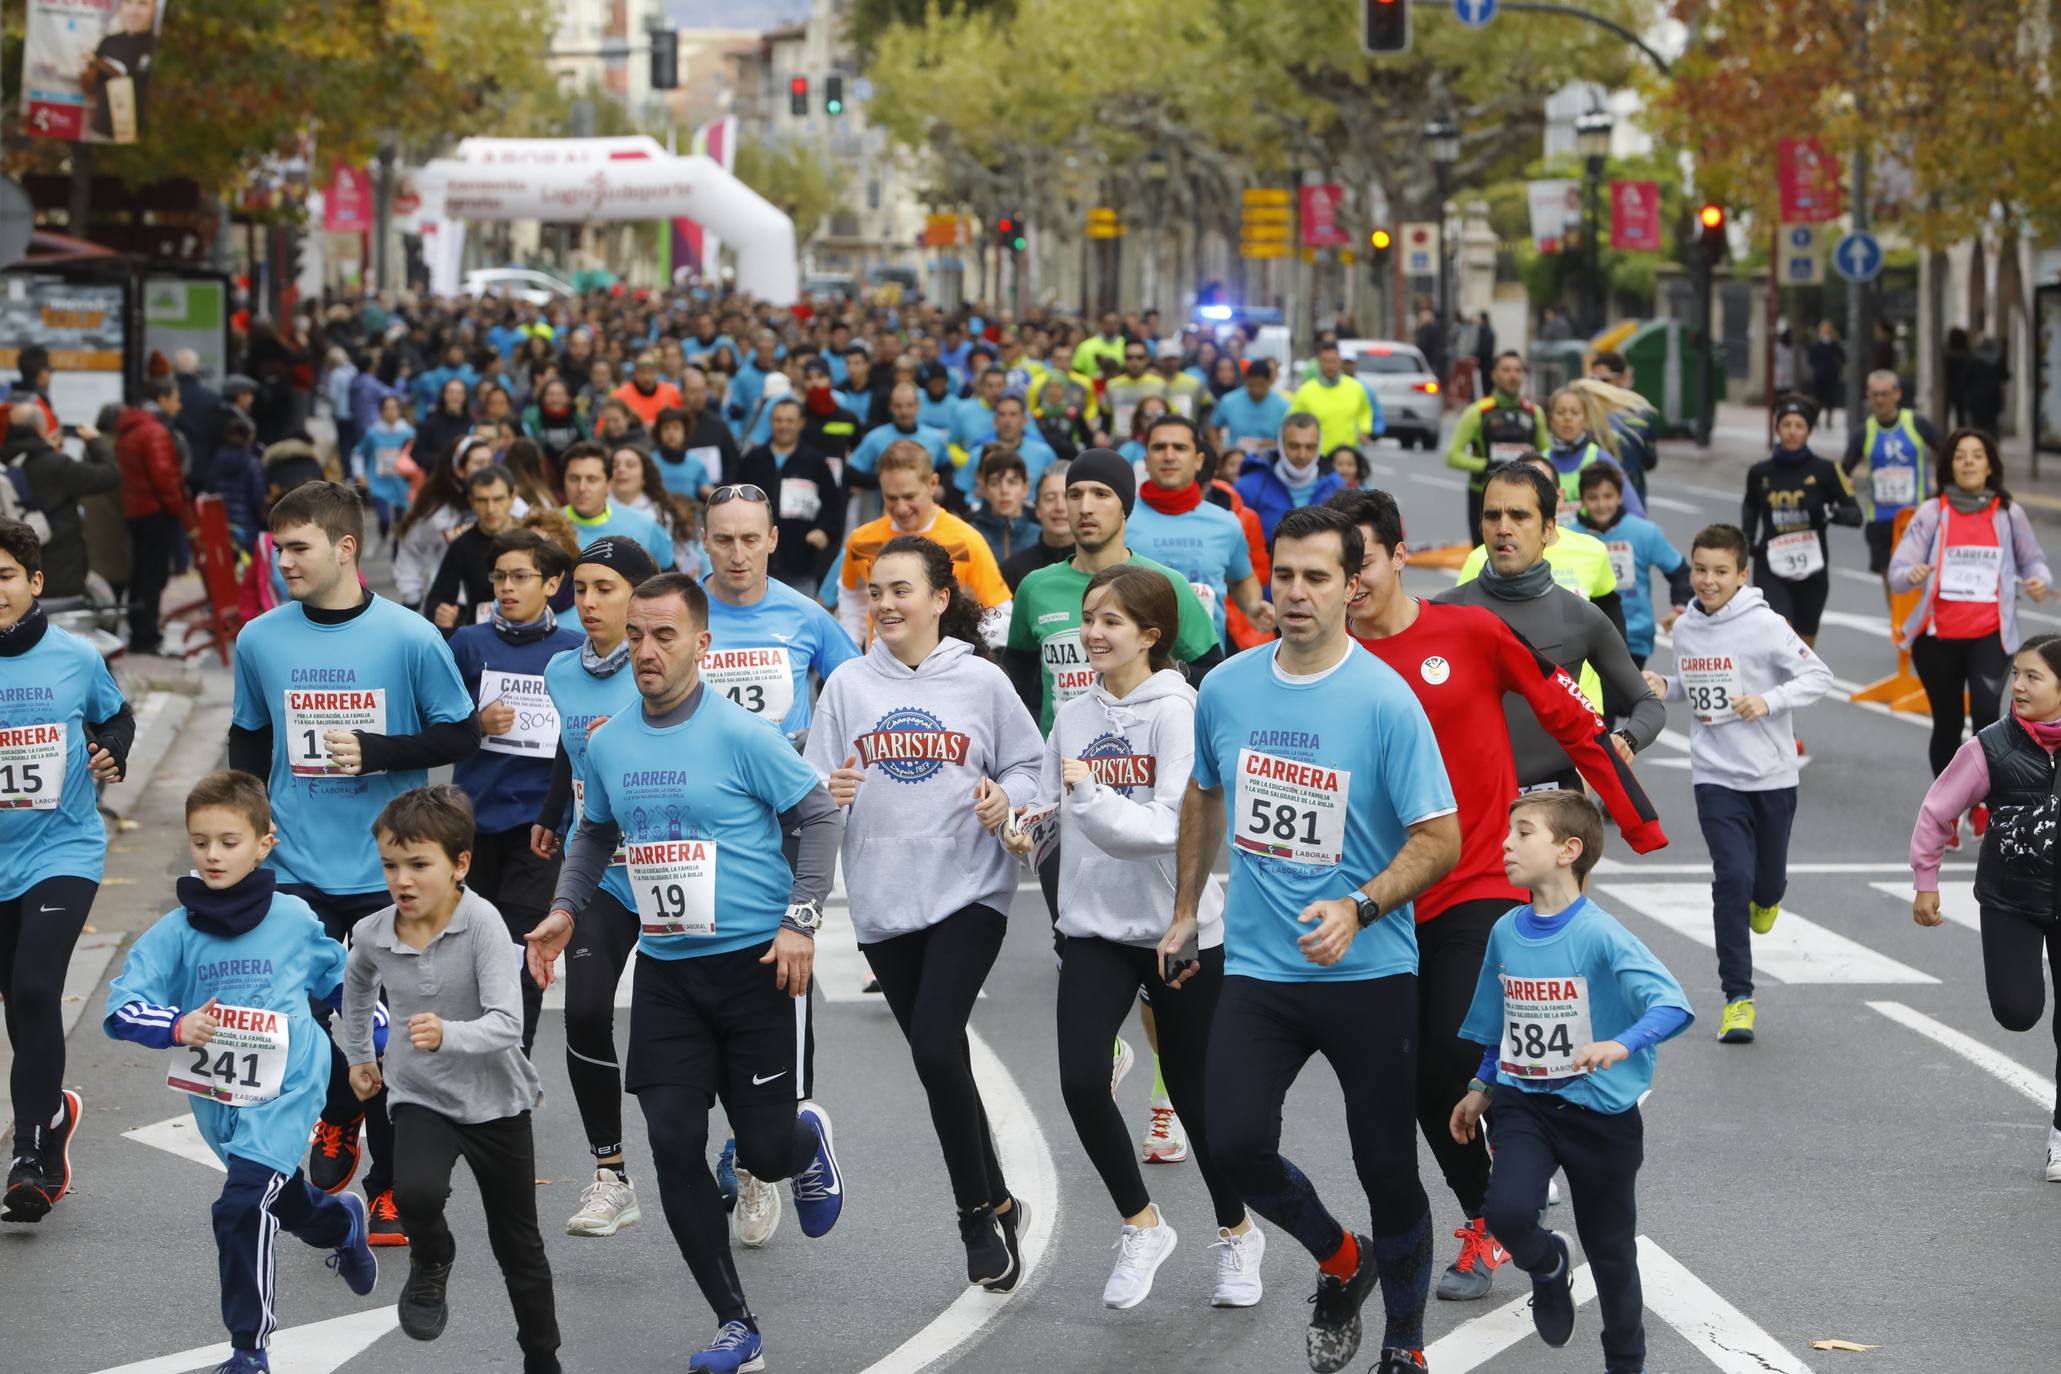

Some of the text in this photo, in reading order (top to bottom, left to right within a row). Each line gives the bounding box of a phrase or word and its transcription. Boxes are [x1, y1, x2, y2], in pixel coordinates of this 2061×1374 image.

[1153, 537, 1204, 547] CARRERA
[701, 650, 782, 669] CARRERA
[1043, 643, 1080, 665] CAJA
[1681, 657, 1733, 671] CARRERA
[291, 668, 356, 683] CARRERA
[290, 691, 377, 710] CARRERA
[1689, 687, 1729, 710] 583
[520, 712, 554, 731] 804
[862, 732, 961, 762] MARISTAS
[1249, 730, 1320, 749] CARRERA
[0, 764, 43, 794] 15
[623, 771, 687, 787] CARRERA
[1091, 758, 1149, 784] RISTAS
[1246, 755, 1338, 792] CARRERA
[1269, 782, 1299, 795] EDUCACIÓN,
[1308, 791, 1330, 800] FAMILIA
[1270, 790, 1300, 803] SALUDABLE
[1249, 798, 1321, 845] 581
[629, 843, 706, 865] CARRERA
[1296, 850, 1330, 859] LABORAL
[1272, 866, 1308, 875] LABORAL
[651, 884, 686, 918] 19
[198, 959, 273, 980] CARRERA
[209, 1007, 278, 1033] RRERA
[215, 1031, 238, 1040] CACIÓN,
[248, 1035, 272, 1043] FAMILIA
[1510, 1021, 1573, 1058] 584
[189, 1047, 261, 1088] 241
